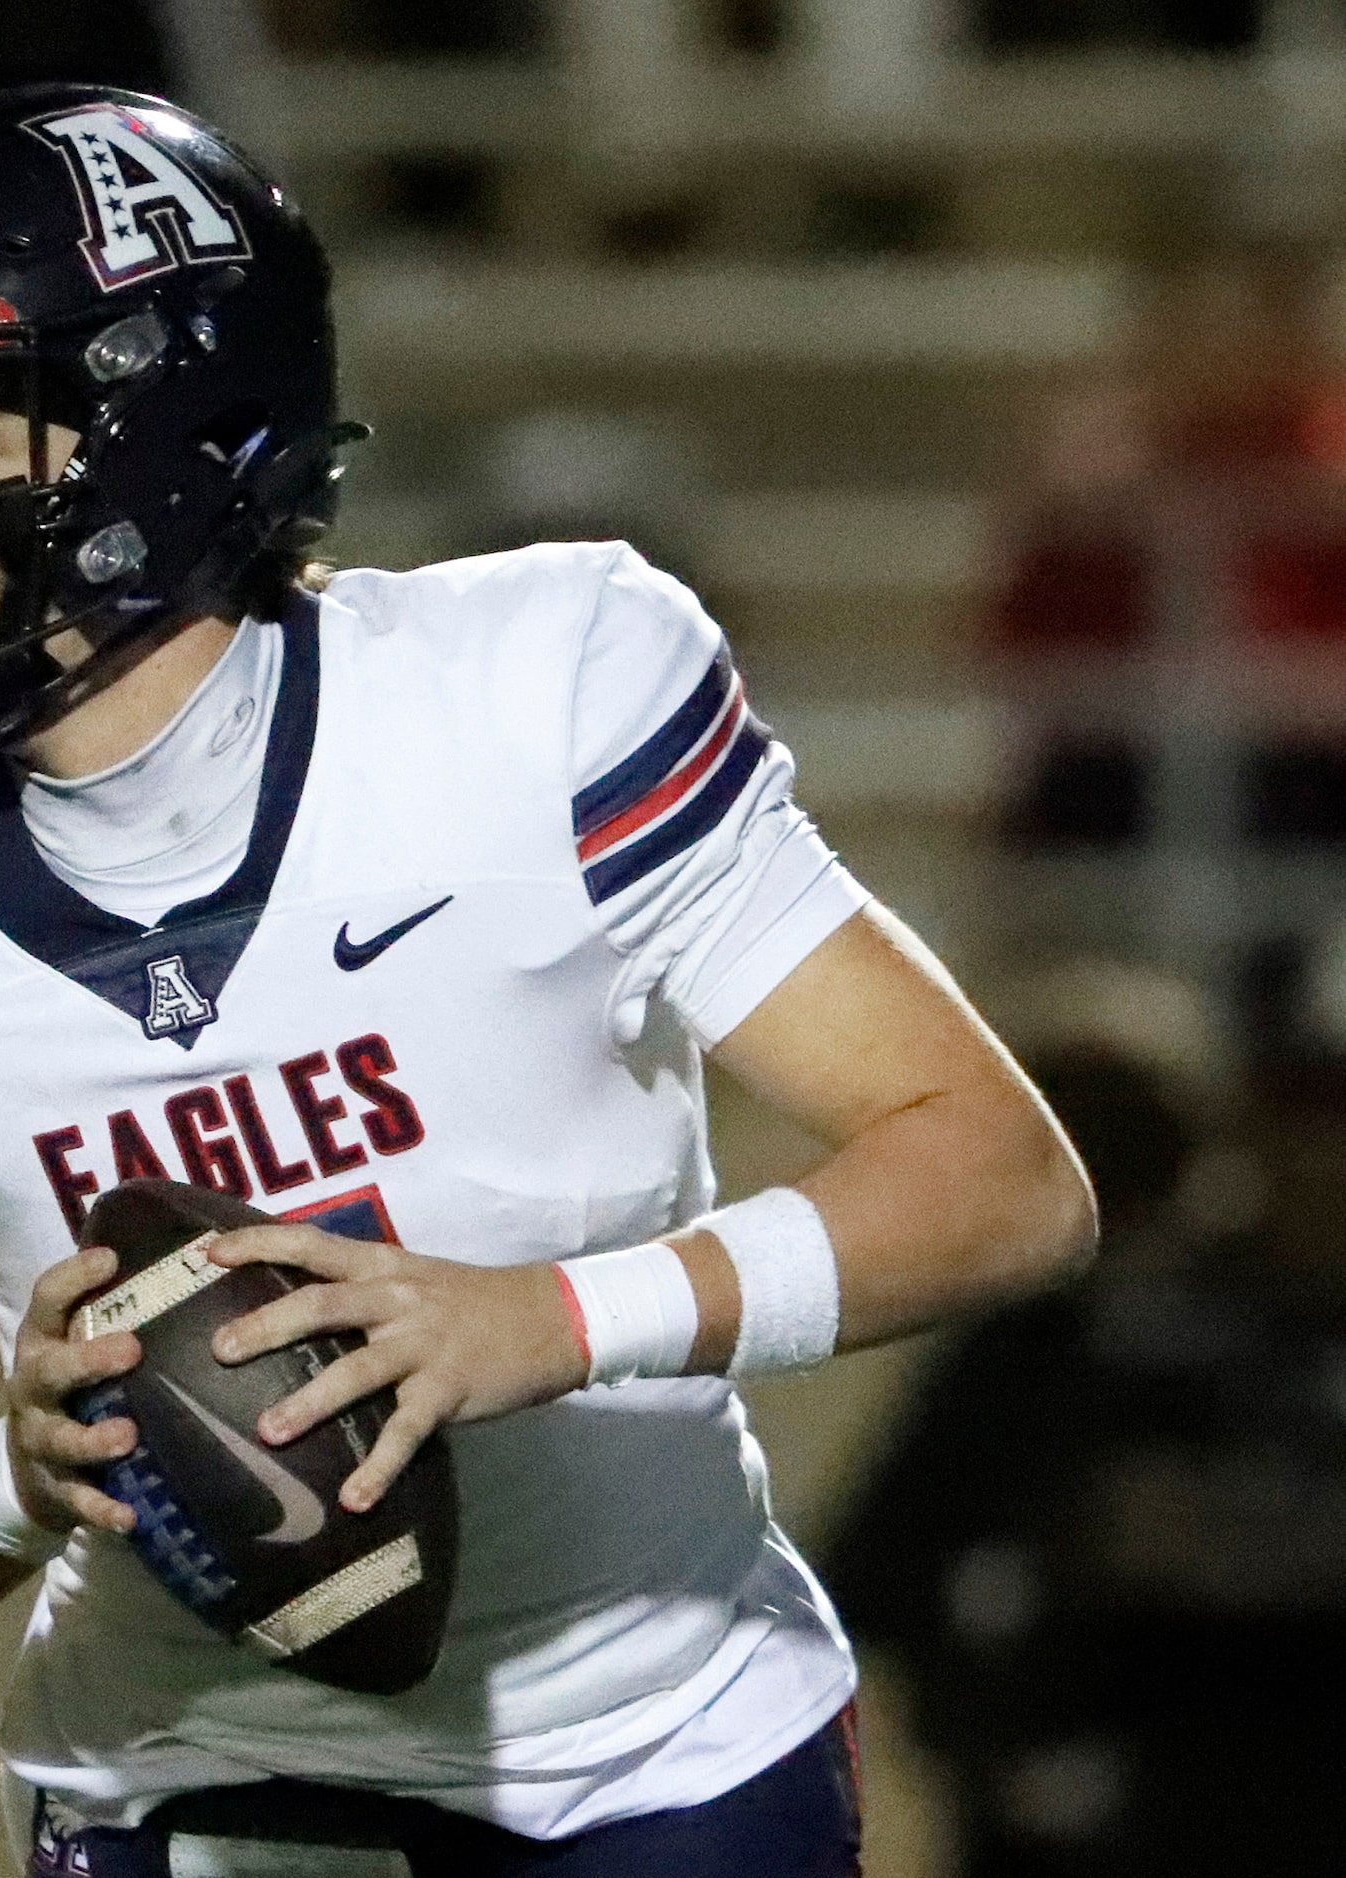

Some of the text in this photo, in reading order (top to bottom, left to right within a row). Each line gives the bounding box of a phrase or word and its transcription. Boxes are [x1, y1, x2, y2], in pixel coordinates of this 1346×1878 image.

[22, 104, 251, 289] A
[145, 954, 212, 1034] A
[32, 1032, 425, 1248] EAGLES
